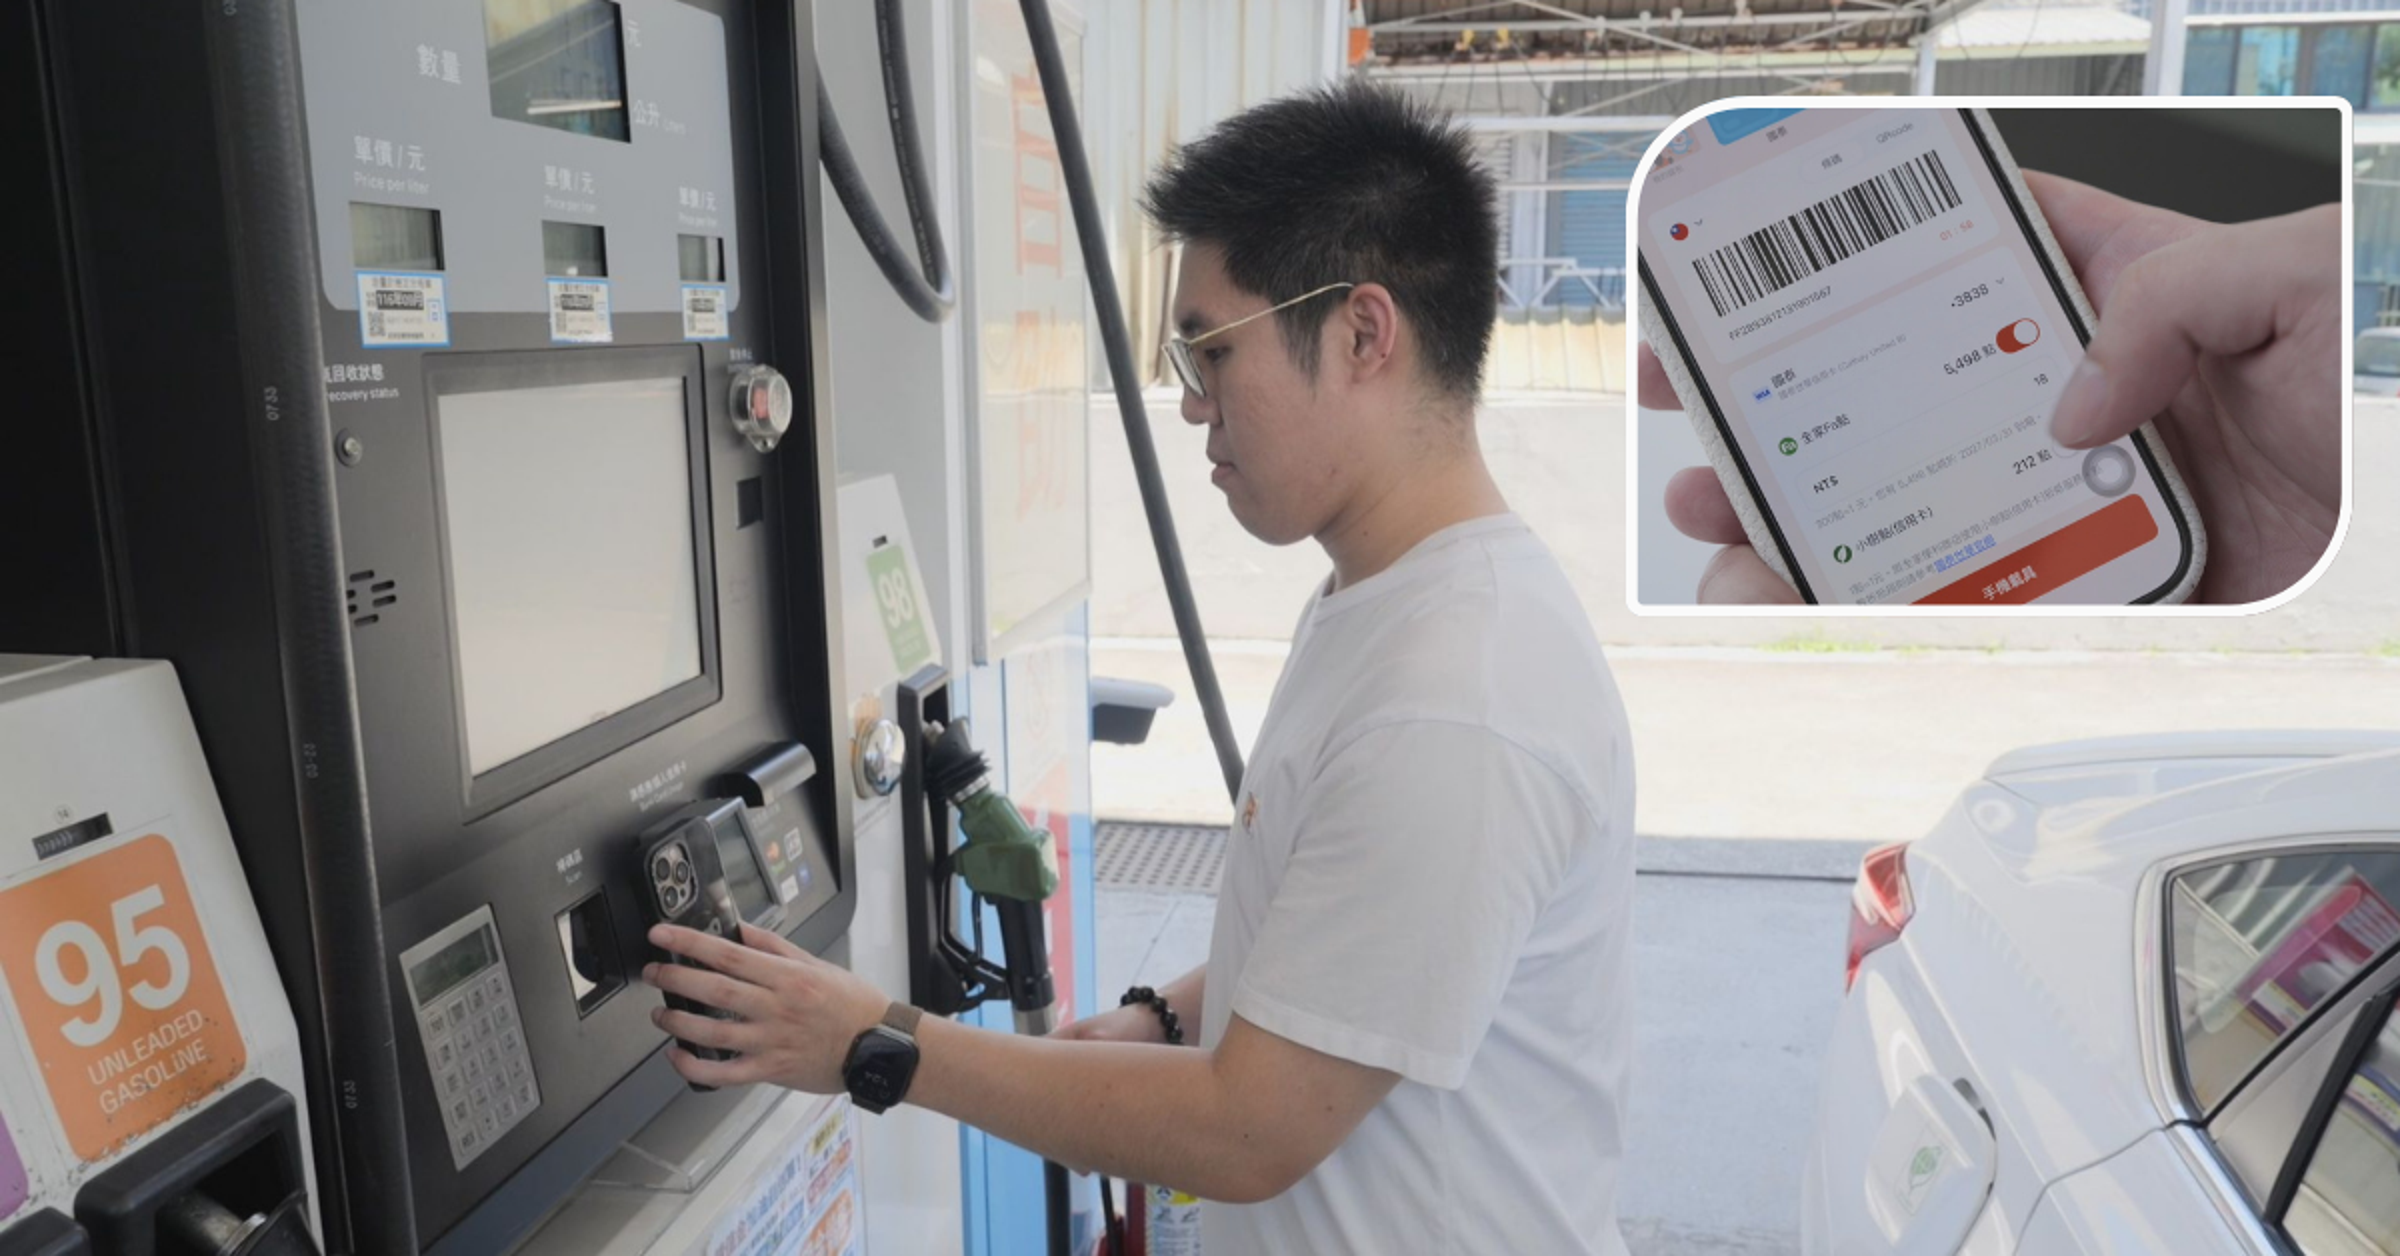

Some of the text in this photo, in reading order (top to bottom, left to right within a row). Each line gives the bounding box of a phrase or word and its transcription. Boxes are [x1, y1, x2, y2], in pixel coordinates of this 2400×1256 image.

[416, 43, 462, 84] 數量
[353, 171, 385, 191] Price
[877, 566, 915, 630] 98
[34, 883, 191, 1047] 95
[87, 1009, 203, 1086] UNLEADED
